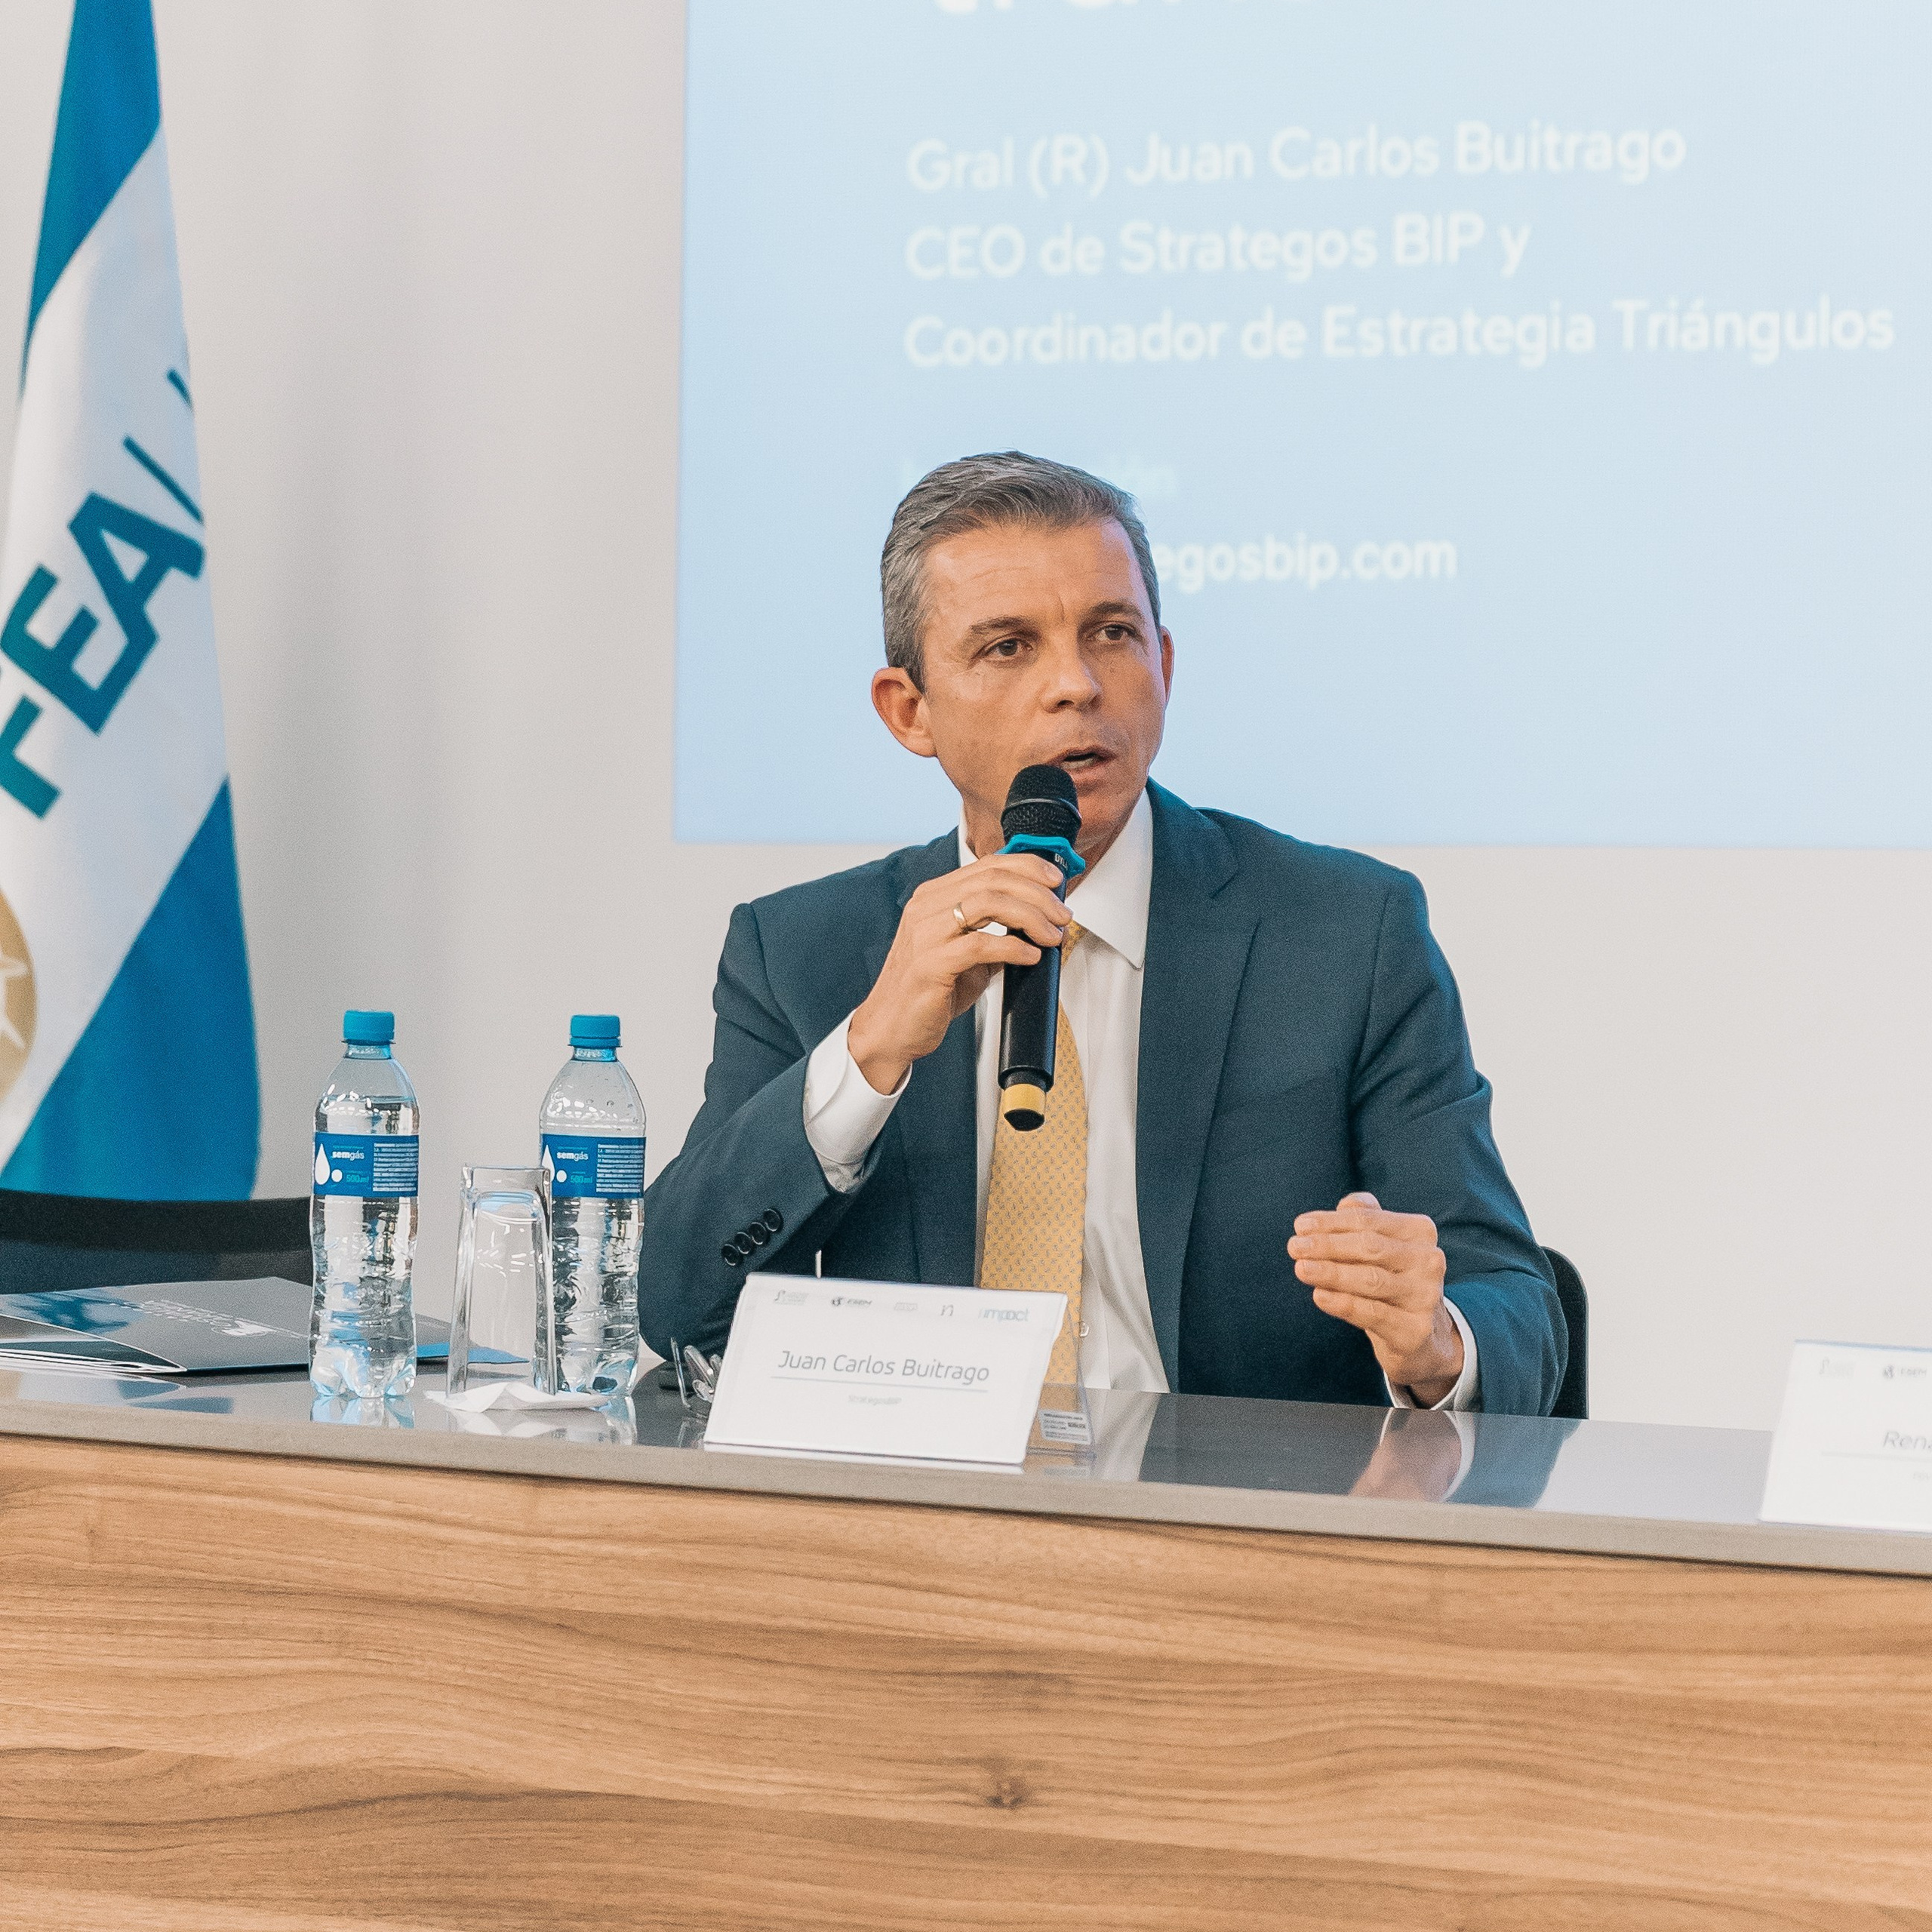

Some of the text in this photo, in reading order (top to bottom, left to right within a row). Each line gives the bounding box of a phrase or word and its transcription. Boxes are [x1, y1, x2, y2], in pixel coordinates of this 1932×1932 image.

[906, 119, 1686, 198] Gral (R) Juan Carlos Buitrago
[905, 211, 1530, 283] CEO de Strategos BIP y
[903, 294, 1894, 369] Coordinador de Estrategia Triángulos
[1152, 531, 1457, 594] egosbip.com
[778, 1350, 990, 1386] Juan Carlos Buitrago
